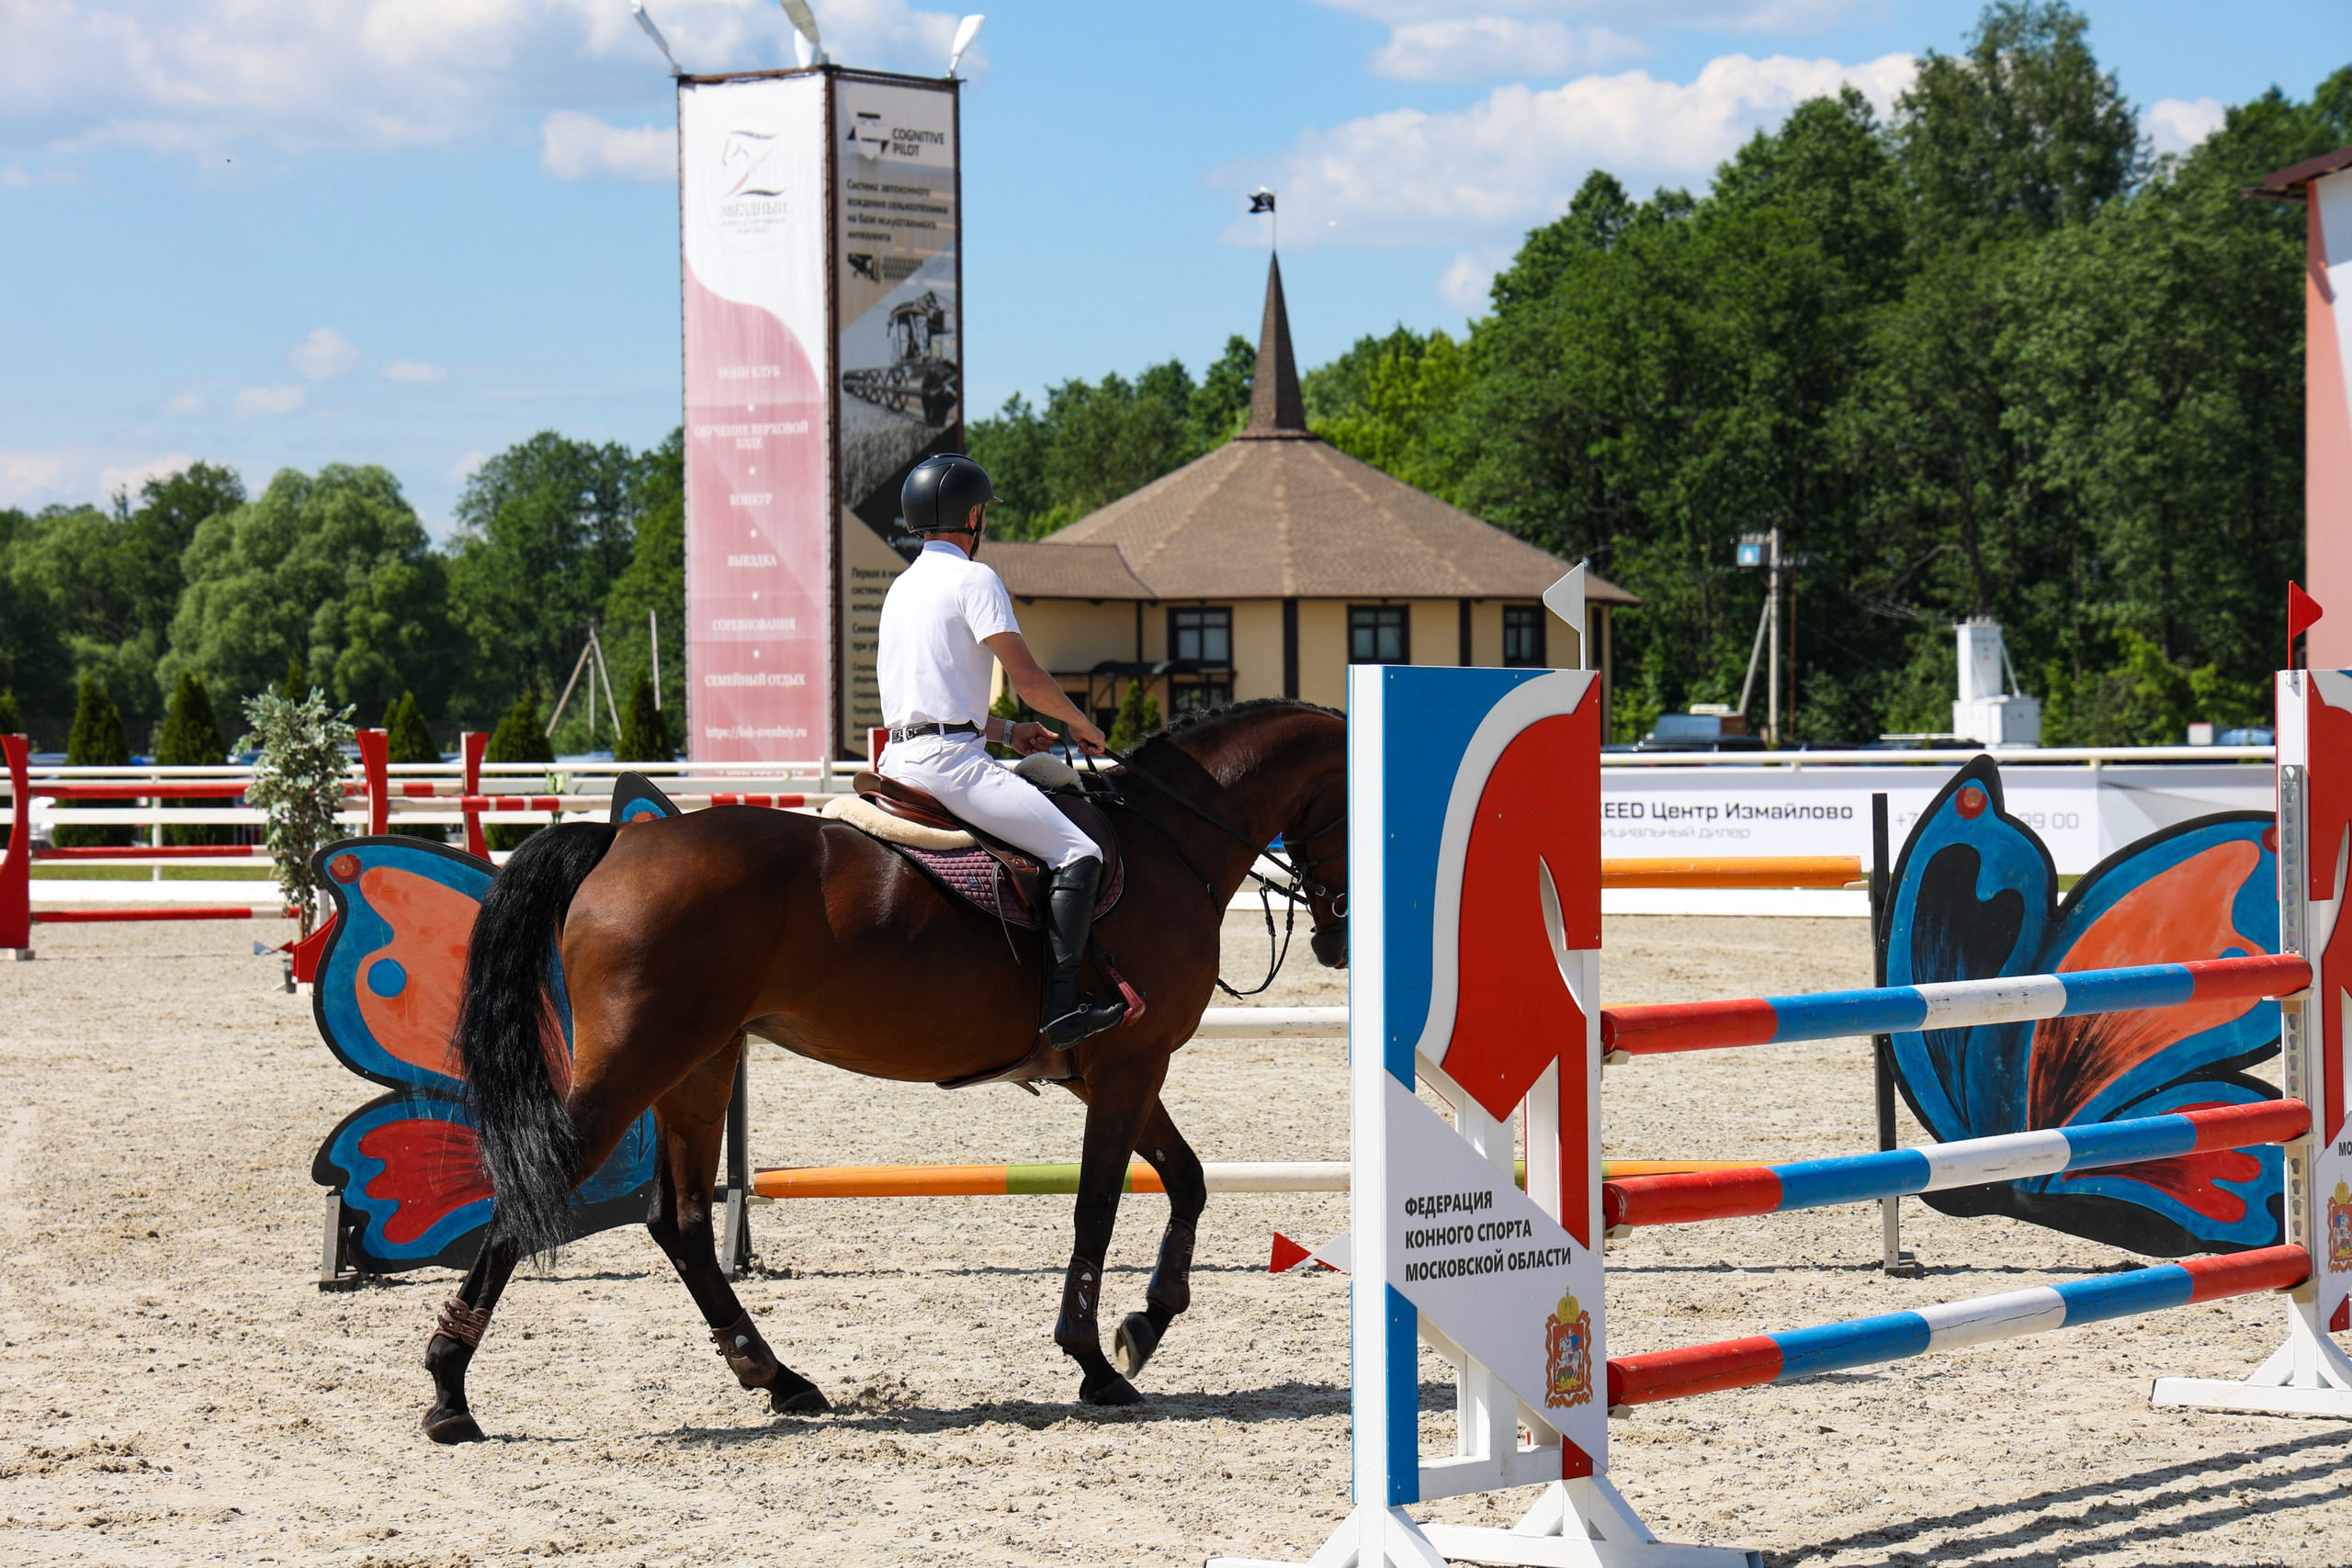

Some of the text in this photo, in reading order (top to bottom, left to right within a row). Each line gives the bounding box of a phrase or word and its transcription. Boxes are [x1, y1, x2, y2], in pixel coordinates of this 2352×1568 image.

[892, 127, 945, 144] COGNITIVE
[893, 142, 921, 156] PILOT
[728, 554, 777, 568] ВЫЕЗДКА
[712, 617, 796, 632] СОРЕВНОВАНИЯ
[705, 672, 806, 687] СЕМЕЙНЫЙ ОТДЫХ
[1600, 802, 1854, 821] EED Центр Измайлово
[1405, 1190, 1493, 1219] ФЕДЕРАЦИЯ
[1405, 1219, 1532, 1249] КОННОГО СПОРТА
[1405, 1247, 1572, 1281] МОСКОВСКОЙ ОБЛАСТИ
